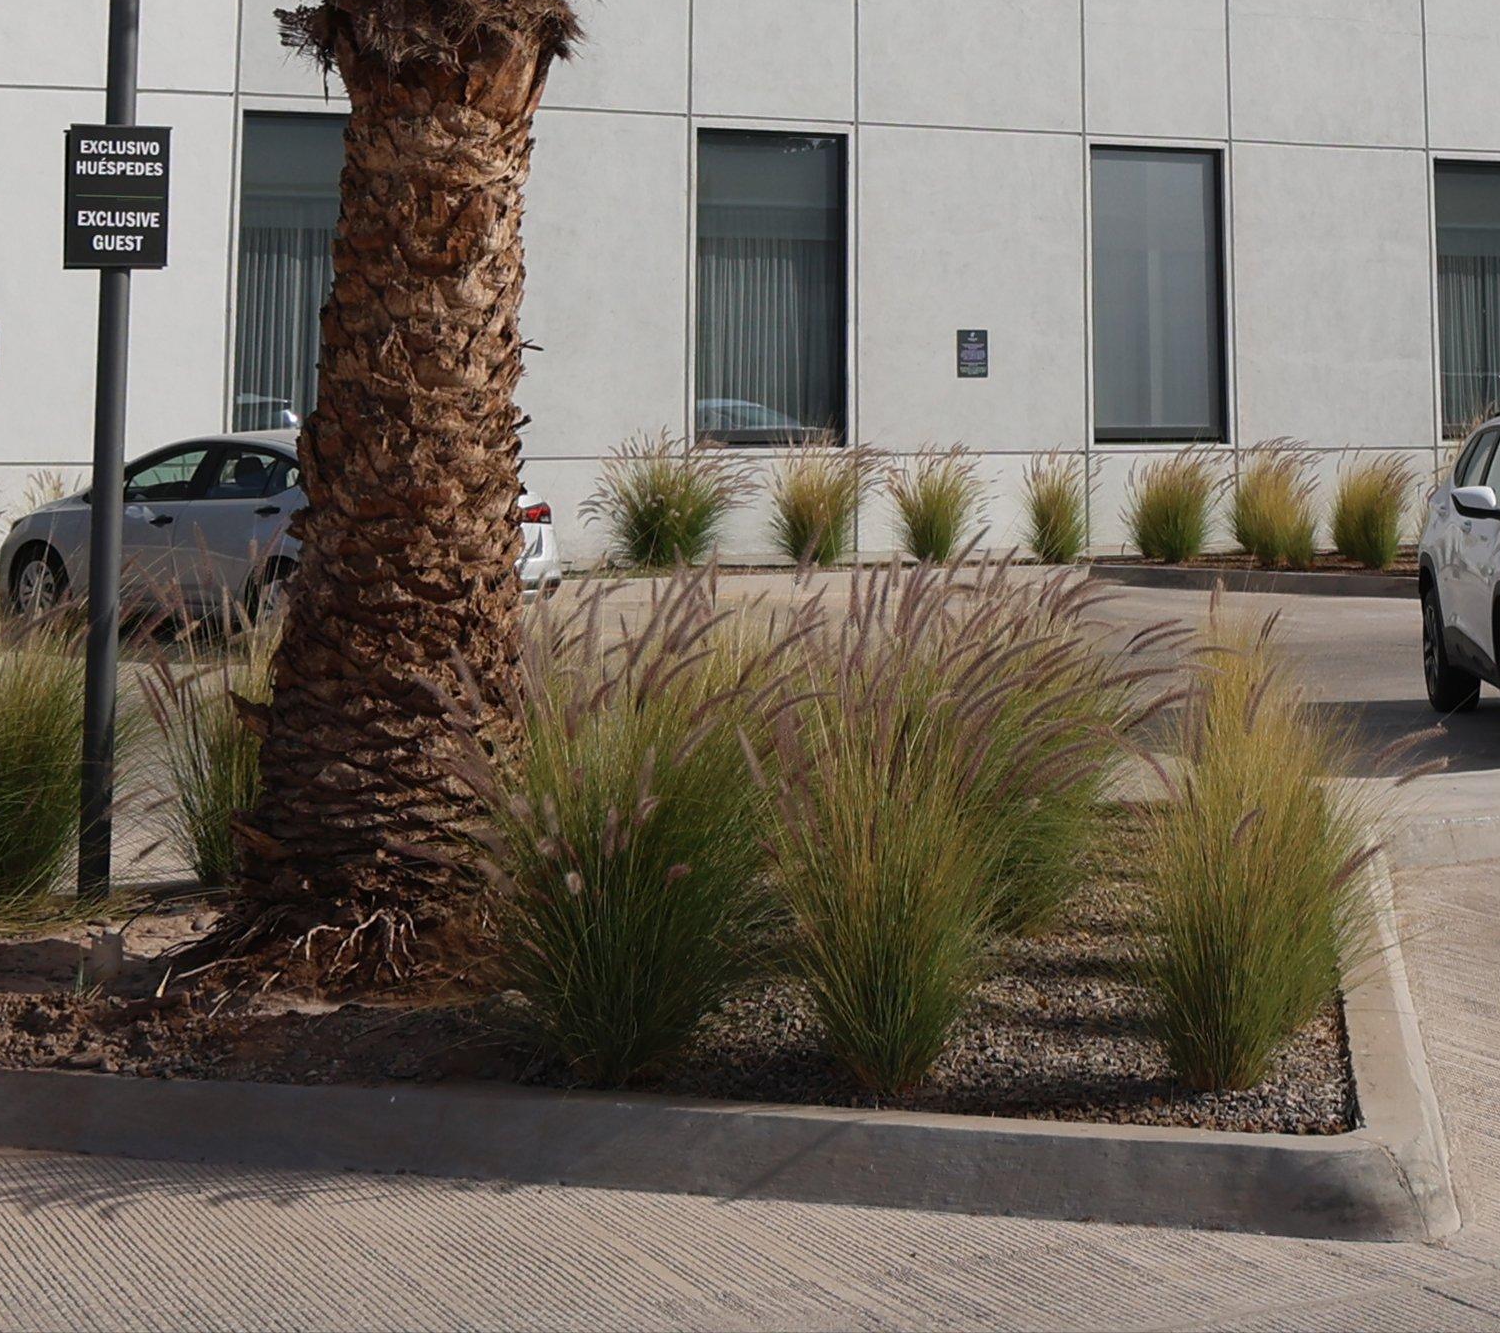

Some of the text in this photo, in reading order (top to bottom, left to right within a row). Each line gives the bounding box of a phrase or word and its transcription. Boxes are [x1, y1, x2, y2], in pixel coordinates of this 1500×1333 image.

[80, 139, 160, 156] EXCLUSIVO
[76, 157, 163, 176] HUÉSPEDES
[77, 210, 160, 228] EXCLUSIVE
[92, 235, 143, 251] GUEST
